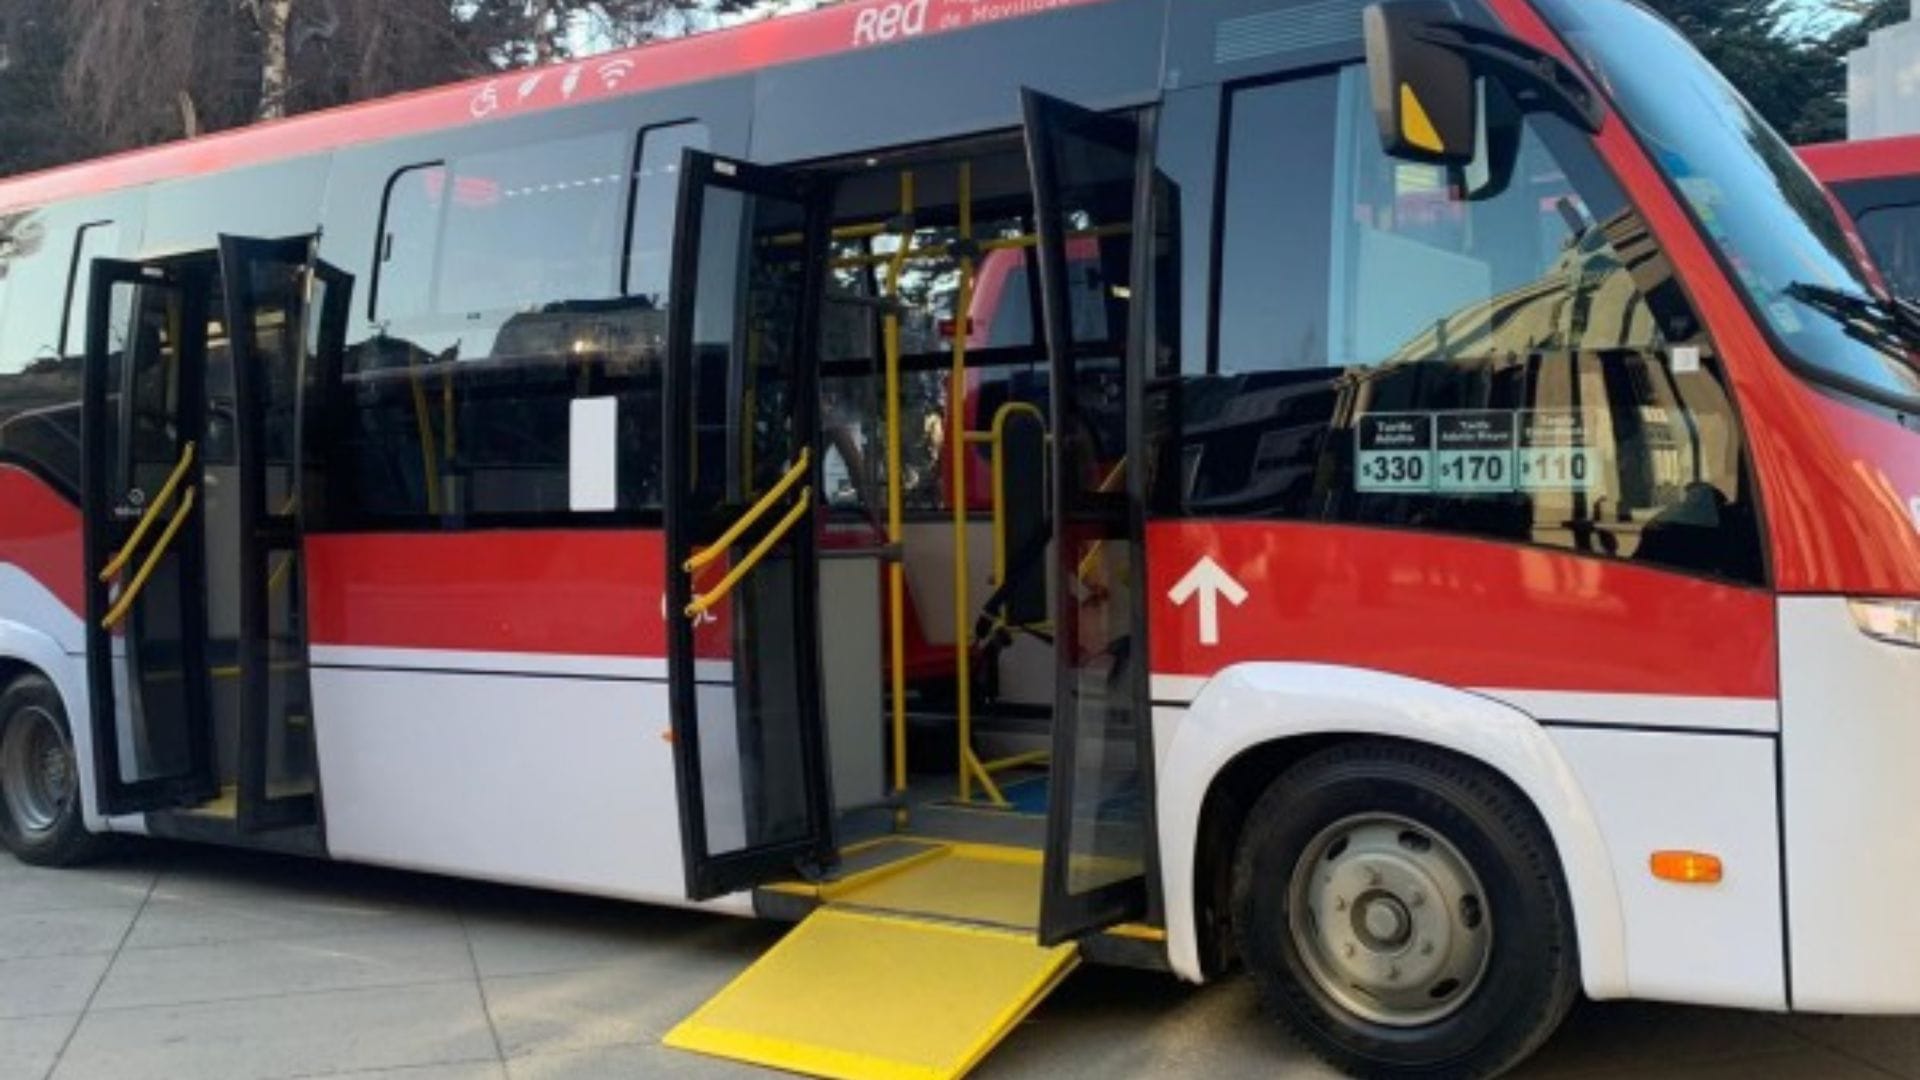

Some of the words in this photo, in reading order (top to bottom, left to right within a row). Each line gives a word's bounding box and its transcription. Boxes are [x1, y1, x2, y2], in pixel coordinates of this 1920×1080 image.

[854, 0, 929, 46] Red
[1363, 456, 1423, 481] $330
[1442, 456, 1502, 481] $170
